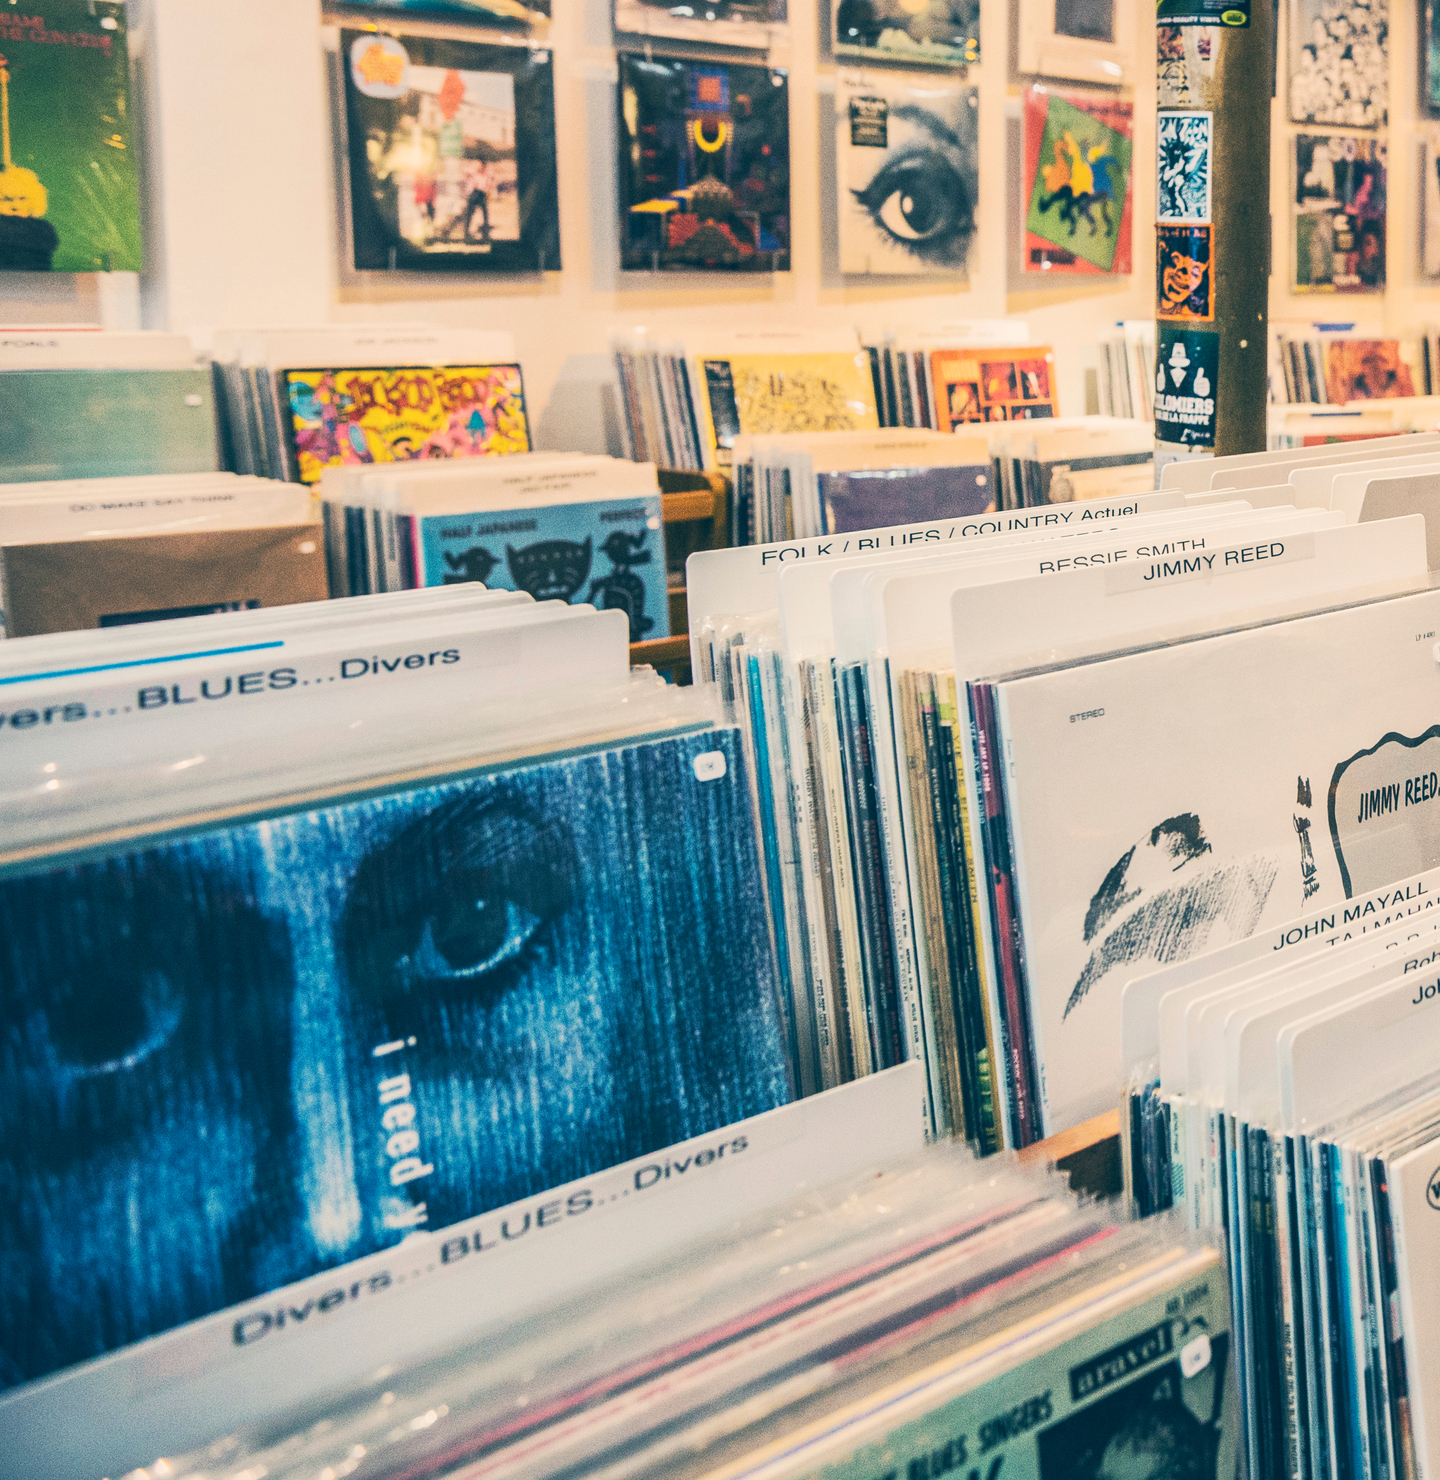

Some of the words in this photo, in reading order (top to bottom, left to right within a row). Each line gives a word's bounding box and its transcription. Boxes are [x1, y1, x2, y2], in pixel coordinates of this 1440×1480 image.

[761, 541, 835, 566] FOLK
[857, 529, 942, 552] BLUES
[961, 510, 1075, 537] COUNTRY
[1080, 502, 1139, 523] Actuel
[1136, 537, 1206, 558] SMITH
[1143, 553, 1216, 581] JIMMY
[1225, 542, 1285, 566] REED
[1069, 706, 1106, 724] STEREO
[1357, 781, 1400, 824] JIMMY
[967, 858, 978, 904] SMITH
[1273, 914, 1336, 951] JOHN
[1343, 881, 1429, 924] MAYALL
[372, 1035, 418, 1058] i
[377, 1070, 434, 1185] need
